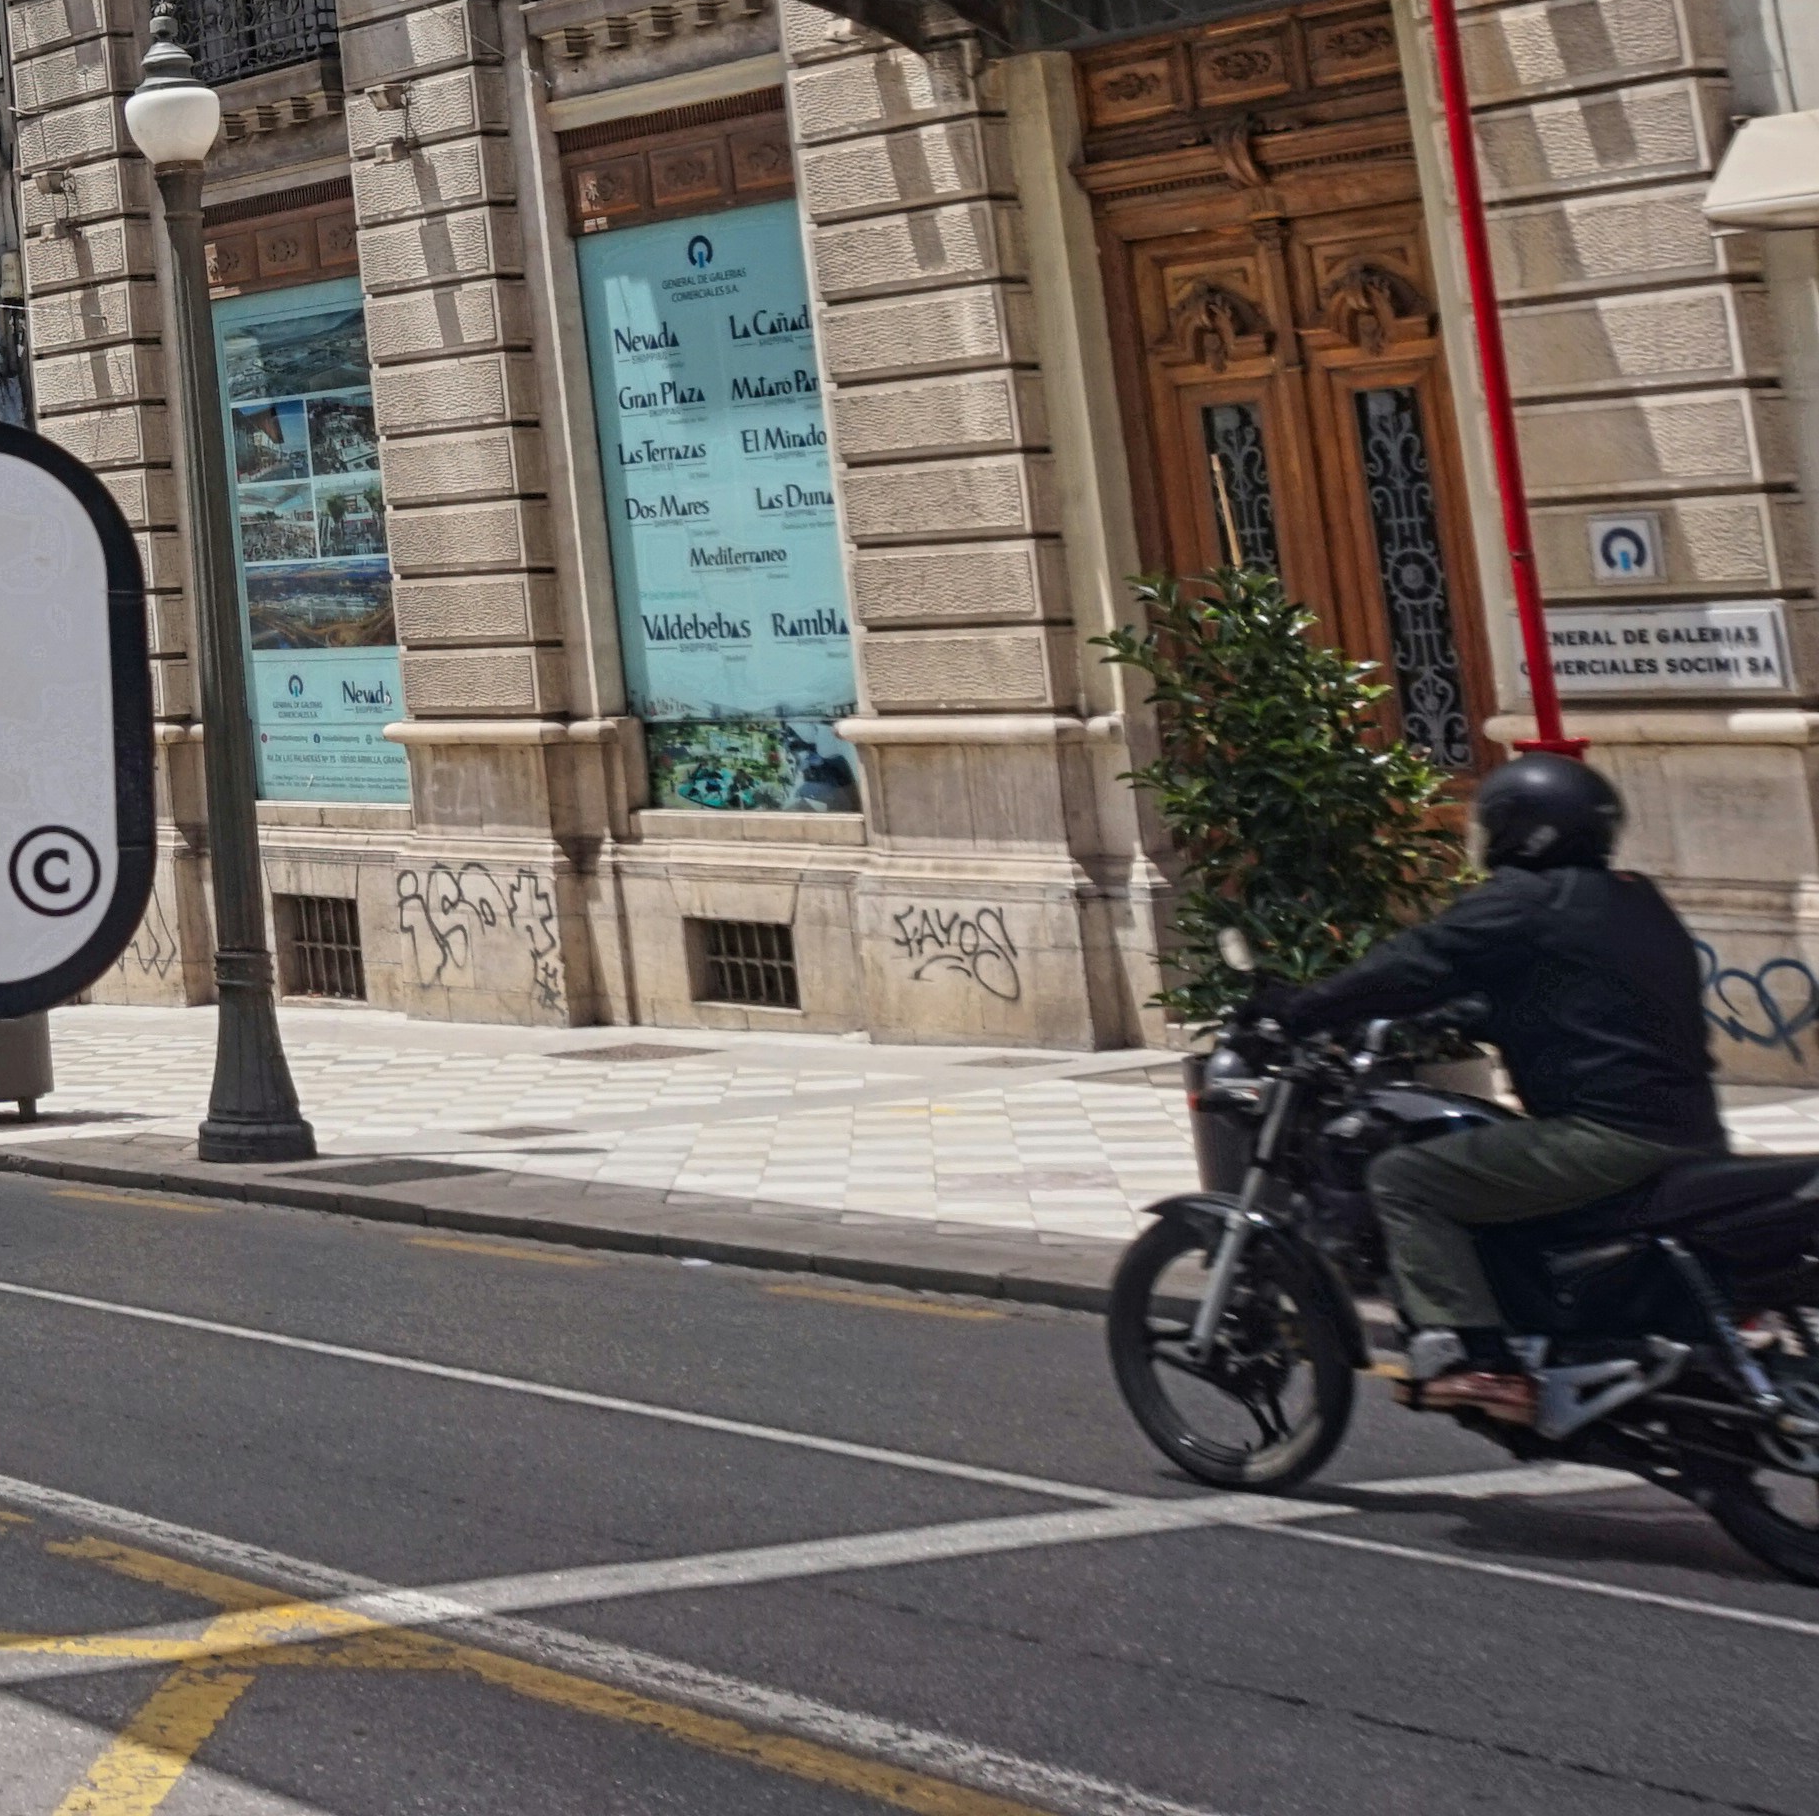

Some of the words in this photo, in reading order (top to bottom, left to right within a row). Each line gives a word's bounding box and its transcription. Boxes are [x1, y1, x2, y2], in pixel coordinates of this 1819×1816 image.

[752, 304, 810, 335] Cañad
[614, 321, 680, 354] Nevada
[794, 370, 819, 392] Par
[619, 386, 658, 410] Gran
[660, 381, 706, 405] Plaza
[741, 429, 760, 453] El
[765, 423, 827, 450] Mirado
[618, 443, 643, 465] Las
[642, 439, 707, 462] Terrazas
[625, 498, 657, 520] Dos
[660, 495, 710, 517] Mares
[755, 487, 783, 510] Las
[785, 484, 835, 507] Duna
[690, 547, 787, 567] Mediterraneo
[641, 612, 752, 641] Valdebebas
[772, 608, 850, 637] Rambla
[1623, 629, 1649, 646] DE
[1656, 626, 1761, 647] GALERIAS
[1520, 659, 1659, 677] CMERCIALES
